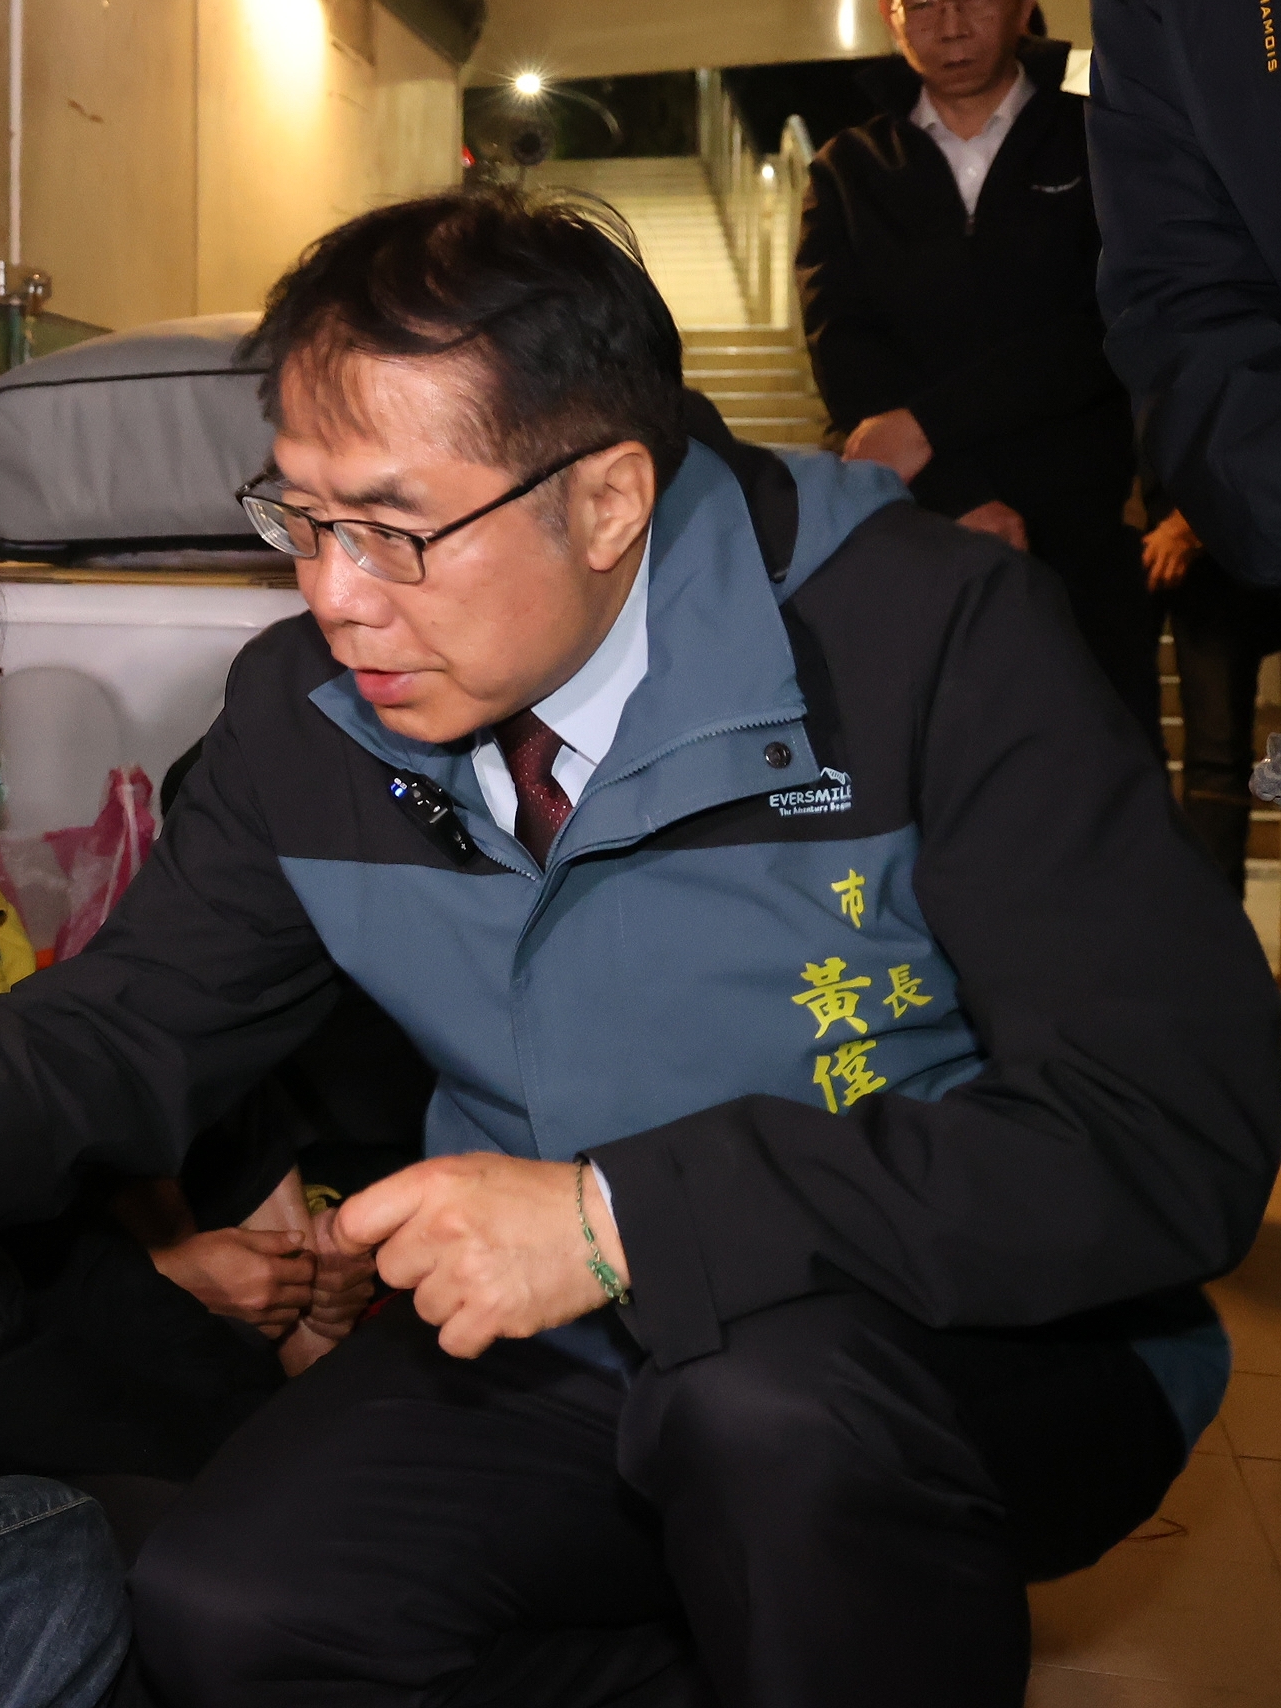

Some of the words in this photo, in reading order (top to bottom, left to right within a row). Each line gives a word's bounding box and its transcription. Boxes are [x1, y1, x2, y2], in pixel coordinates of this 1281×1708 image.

[1259, 0, 1278, 72] AMOIS
[769, 784, 852, 808] EVERSMILE
[830, 868, 934, 1019] 市長
